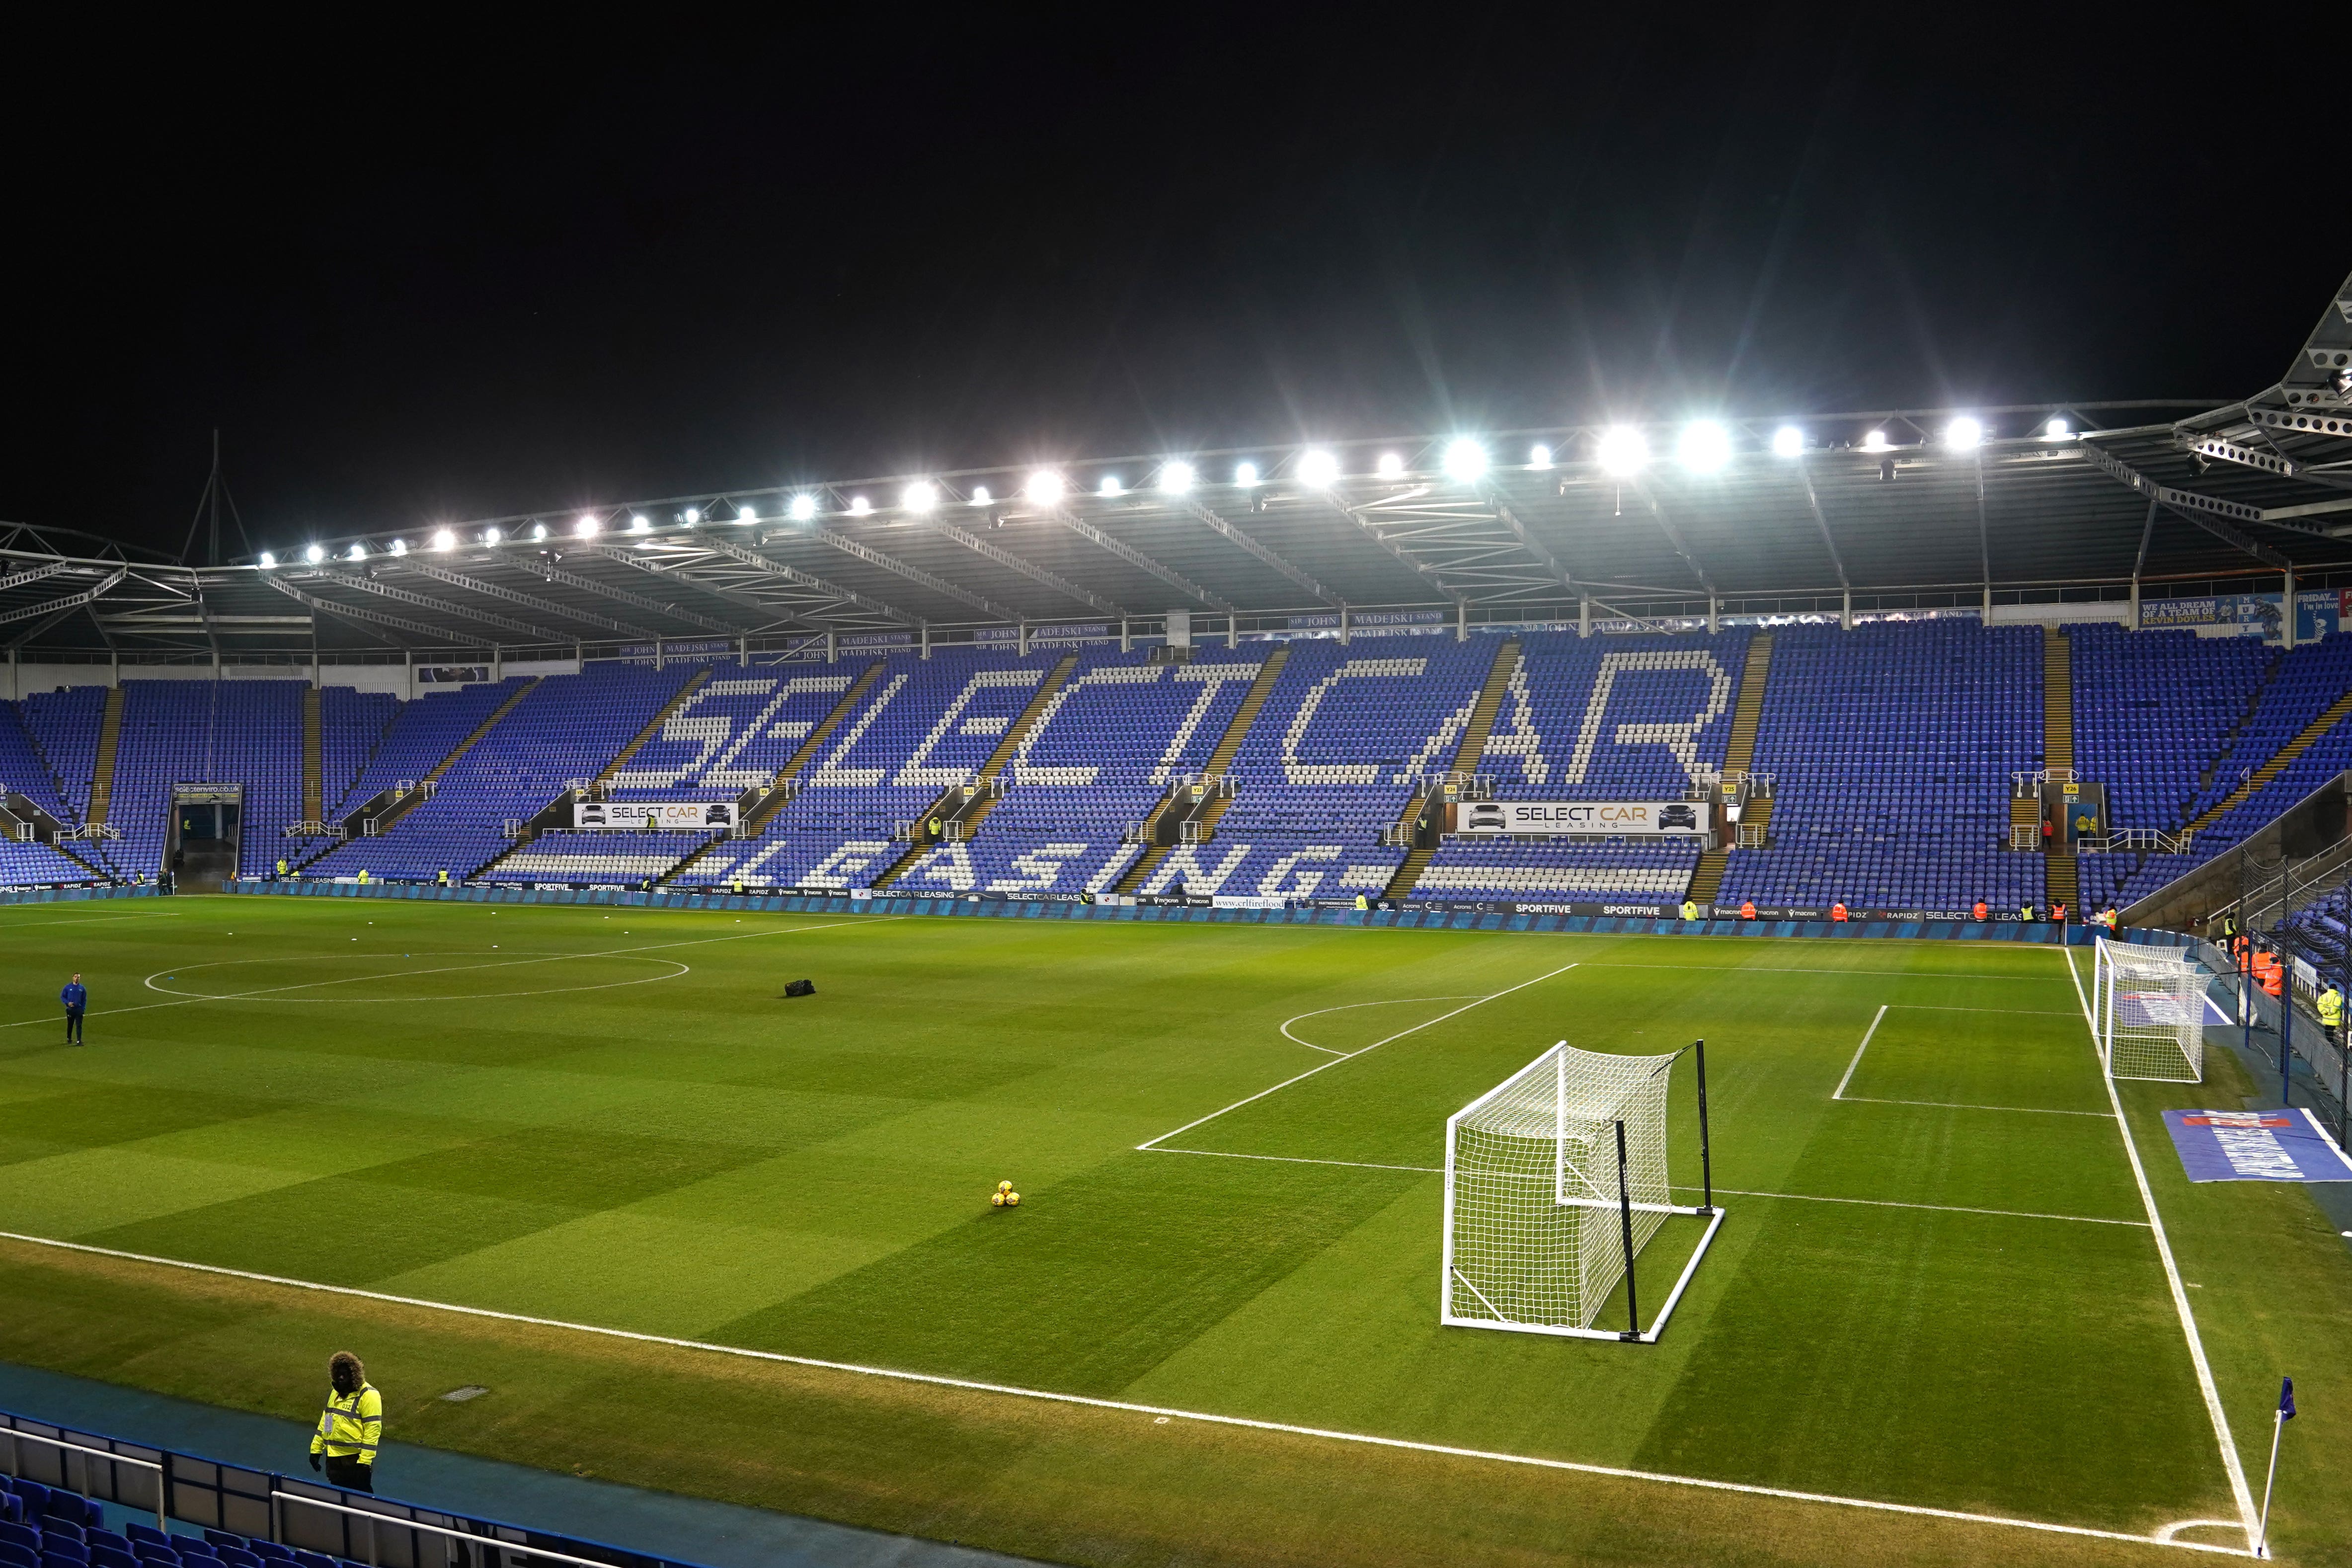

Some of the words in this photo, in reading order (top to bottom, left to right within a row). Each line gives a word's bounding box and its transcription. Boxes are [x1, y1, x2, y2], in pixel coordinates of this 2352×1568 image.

[2168, 608, 2200, 617] TEAM
[1307, 617, 1336, 627] JOHN
[1354, 614, 1412, 624] MADEJSKI
[2142, 617, 2174, 625] KEVIN
[2177, 615, 2215, 623] DOYLES
[991, 629, 1017, 639] JOHN
[1037, 627, 1081, 636] ADEJSKI
[842, 635, 888, 645] MADEJSKI
[633, 646, 655, 654] JOHN
[666, 642, 708, 652] MADEJSKI
[613, 663, 1262, 788] SELECT
[1280, 650, 1731, 785] CAR
[612, 807, 664, 818] SELECT
[667, 807, 699, 818] CAR
[1516, 807, 1594, 821] SELECT
[1600, 807, 1647, 821] CAR
[1515, 904, 1571, 914] SPORTFIVE
[1603, 906, 1660, 915] SPORTFIVE
